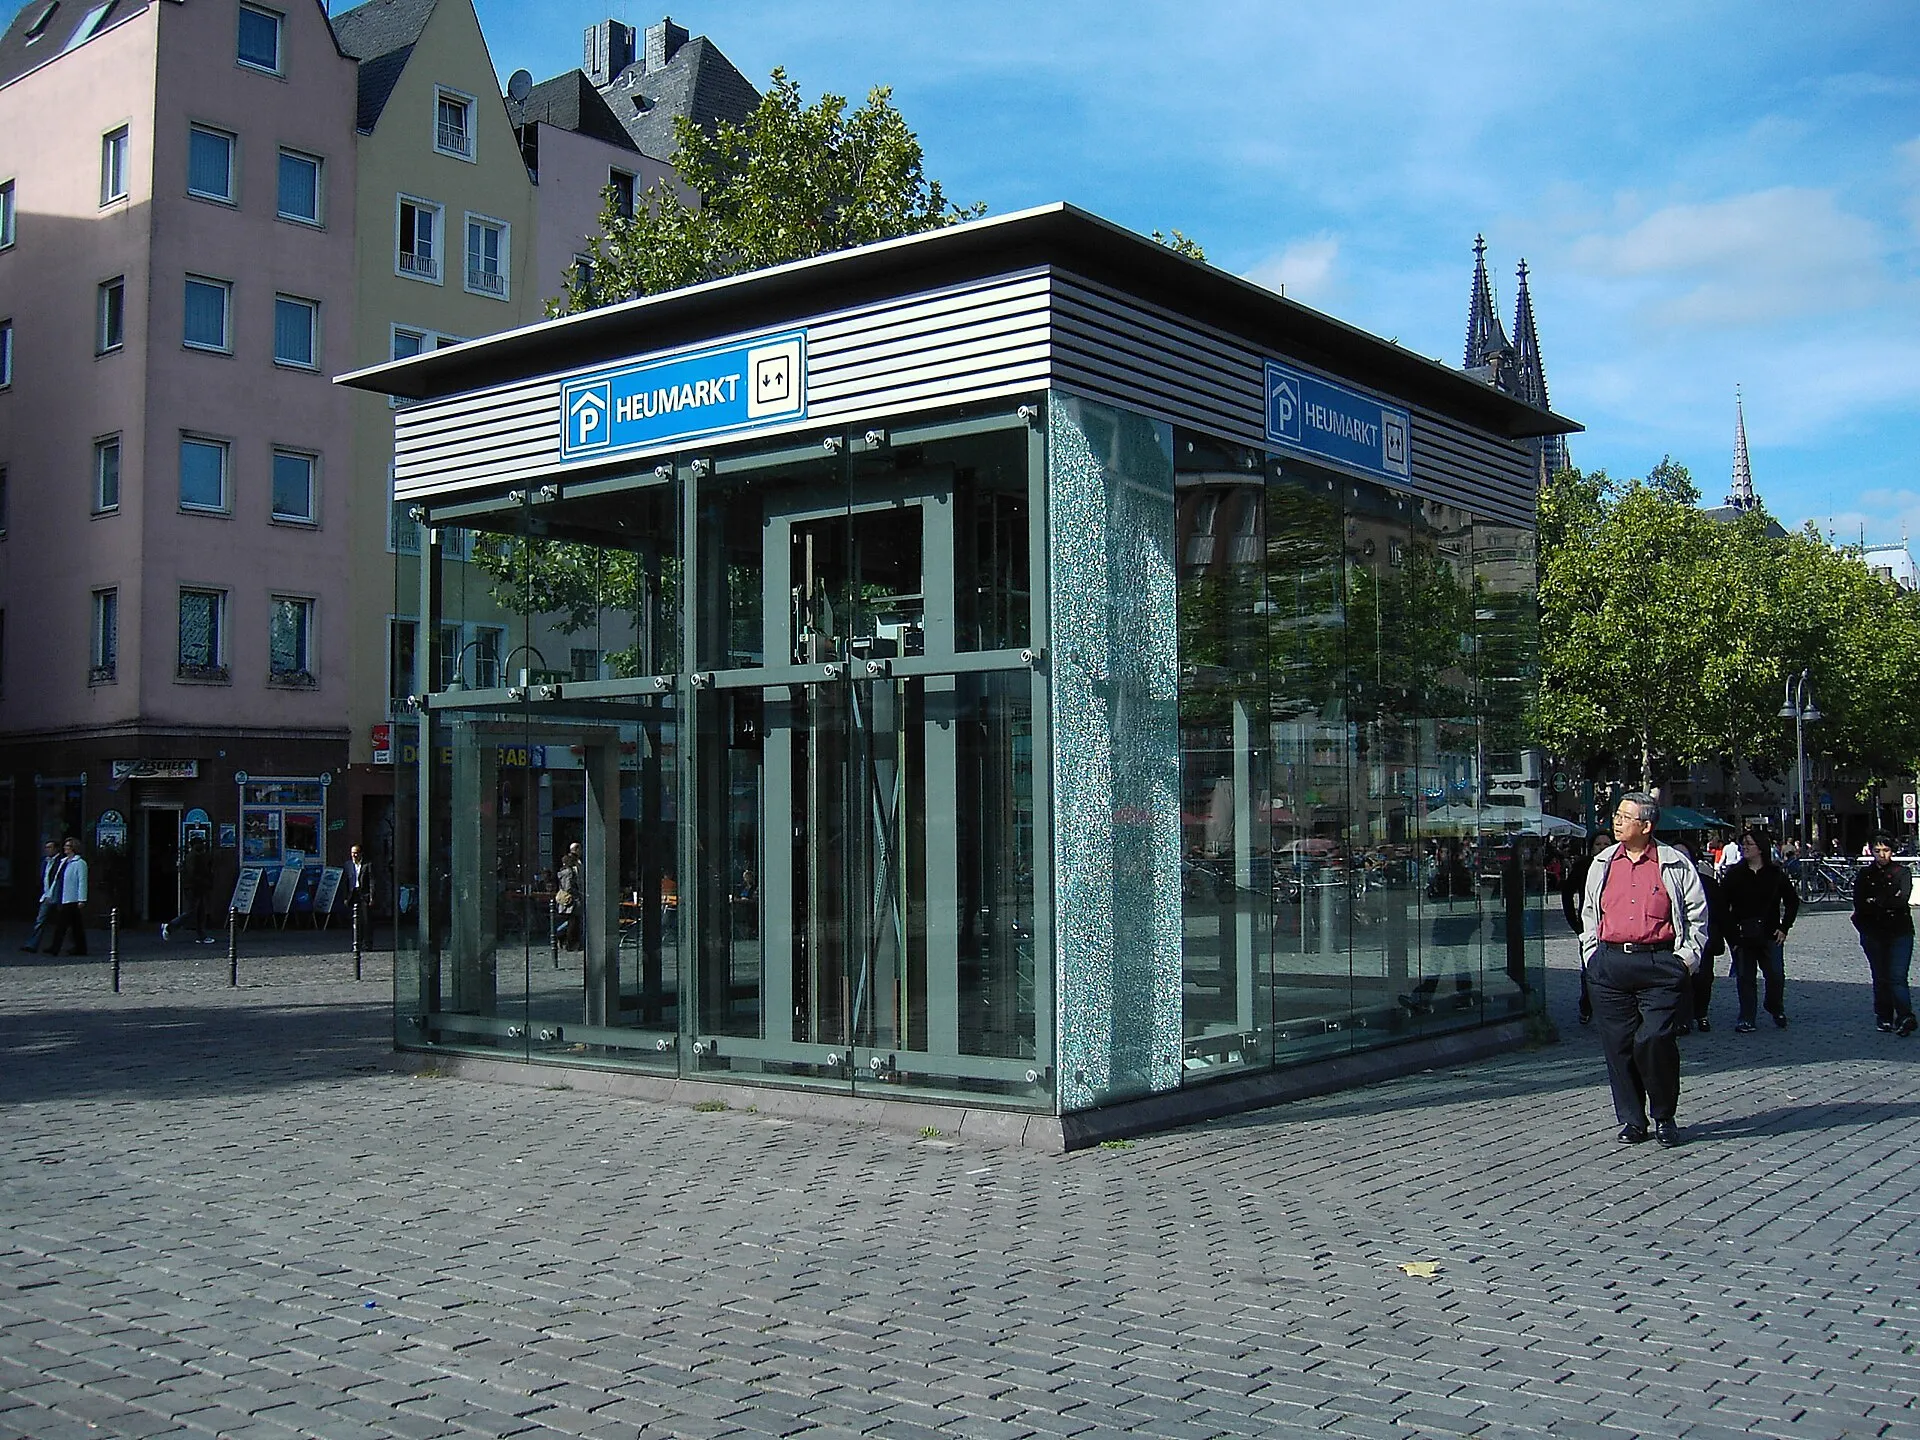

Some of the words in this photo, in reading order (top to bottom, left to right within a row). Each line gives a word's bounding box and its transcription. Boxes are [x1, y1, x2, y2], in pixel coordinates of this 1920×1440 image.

[579, 408, 599, 443] P
[616, 373, 741, 423] HEUMARKT
[1279, 397, 1293, 431] P
[1305, 401, 1378, 447] HEUMARKT
